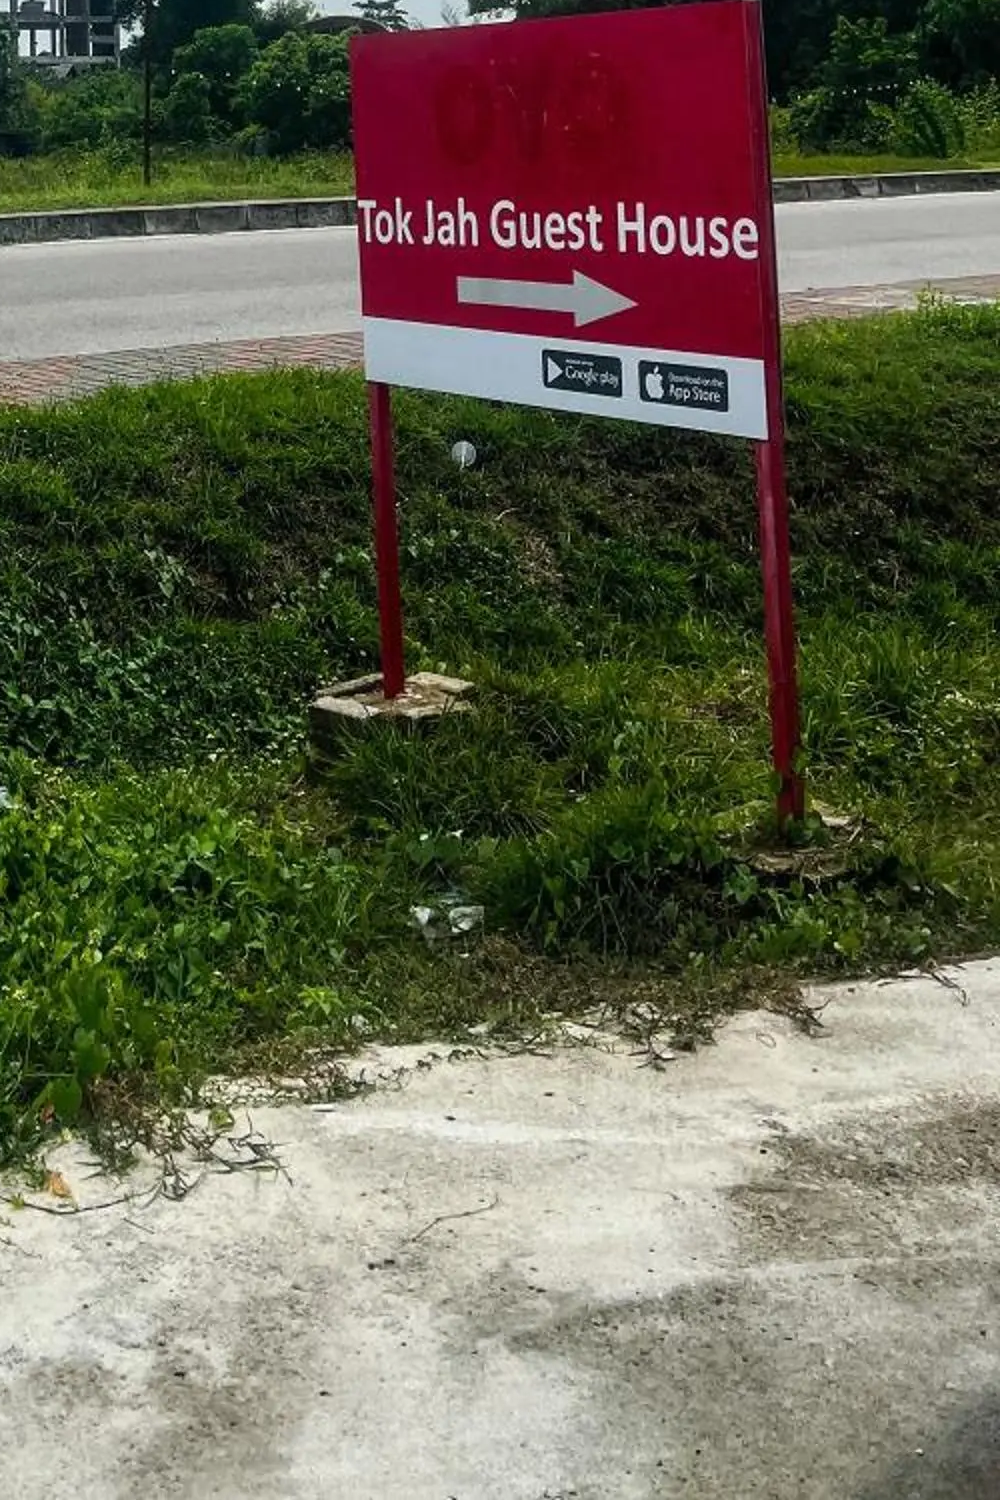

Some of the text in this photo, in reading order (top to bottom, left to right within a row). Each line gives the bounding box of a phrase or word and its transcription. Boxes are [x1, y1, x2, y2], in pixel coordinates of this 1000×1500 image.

[358, 197, 759, 260] Tok Jah Guest House
[565, 365, 598, 387] Google
[669, 383, 721, 403] App Store
